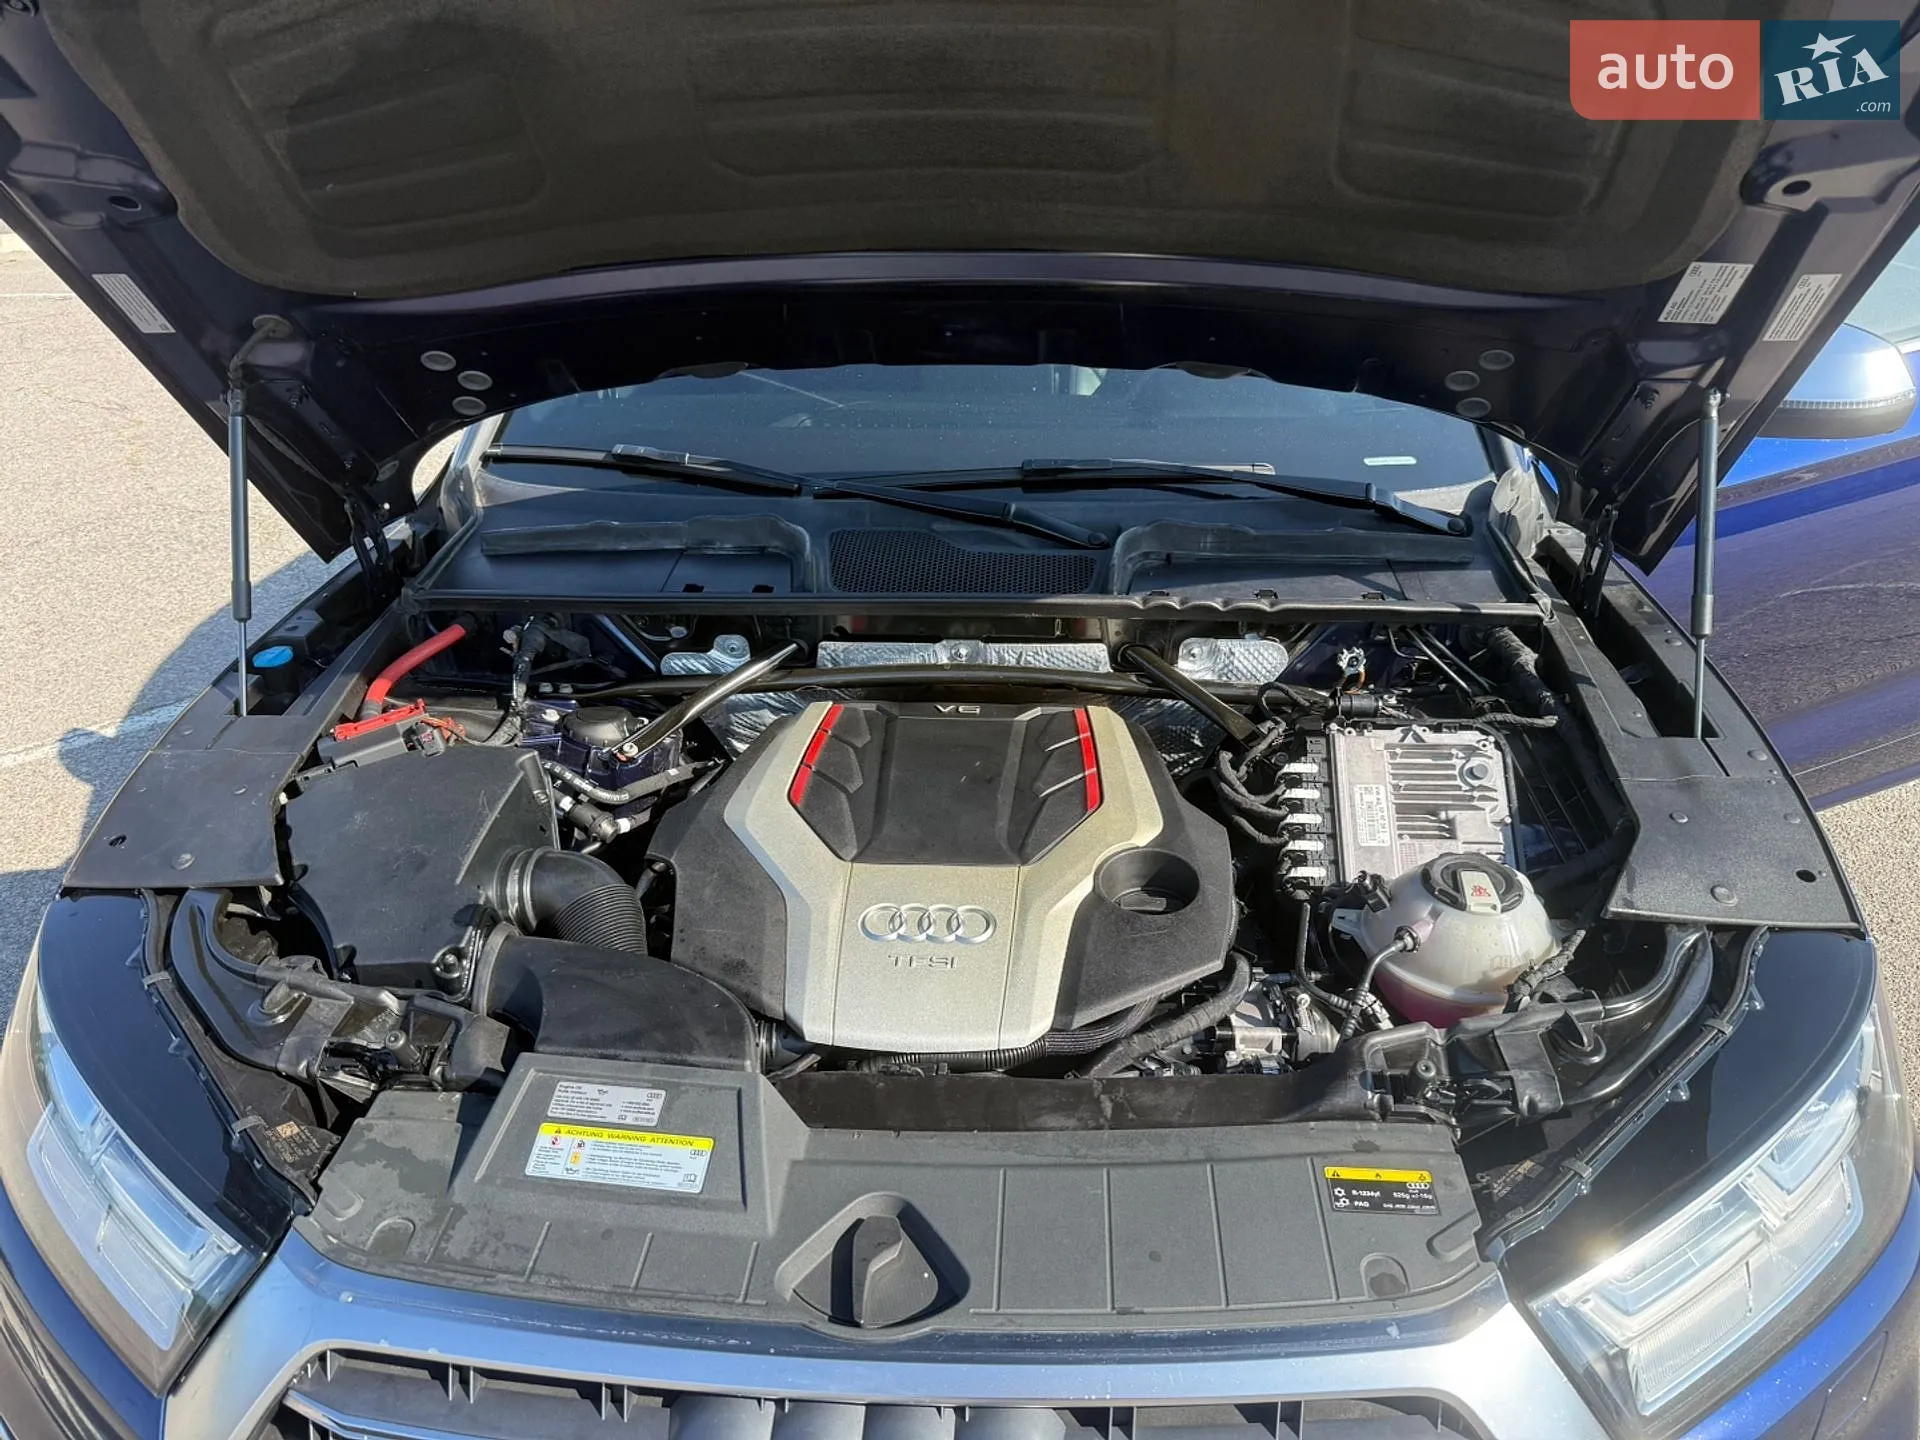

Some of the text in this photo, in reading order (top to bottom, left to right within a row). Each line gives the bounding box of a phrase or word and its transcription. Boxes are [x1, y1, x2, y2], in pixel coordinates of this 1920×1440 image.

[934, 703, 981, 716] V6
[887, 954, 959, 969] TFSI
[564, 1129, 695, 1147] ACHTUNG WARNING ATTENTION
